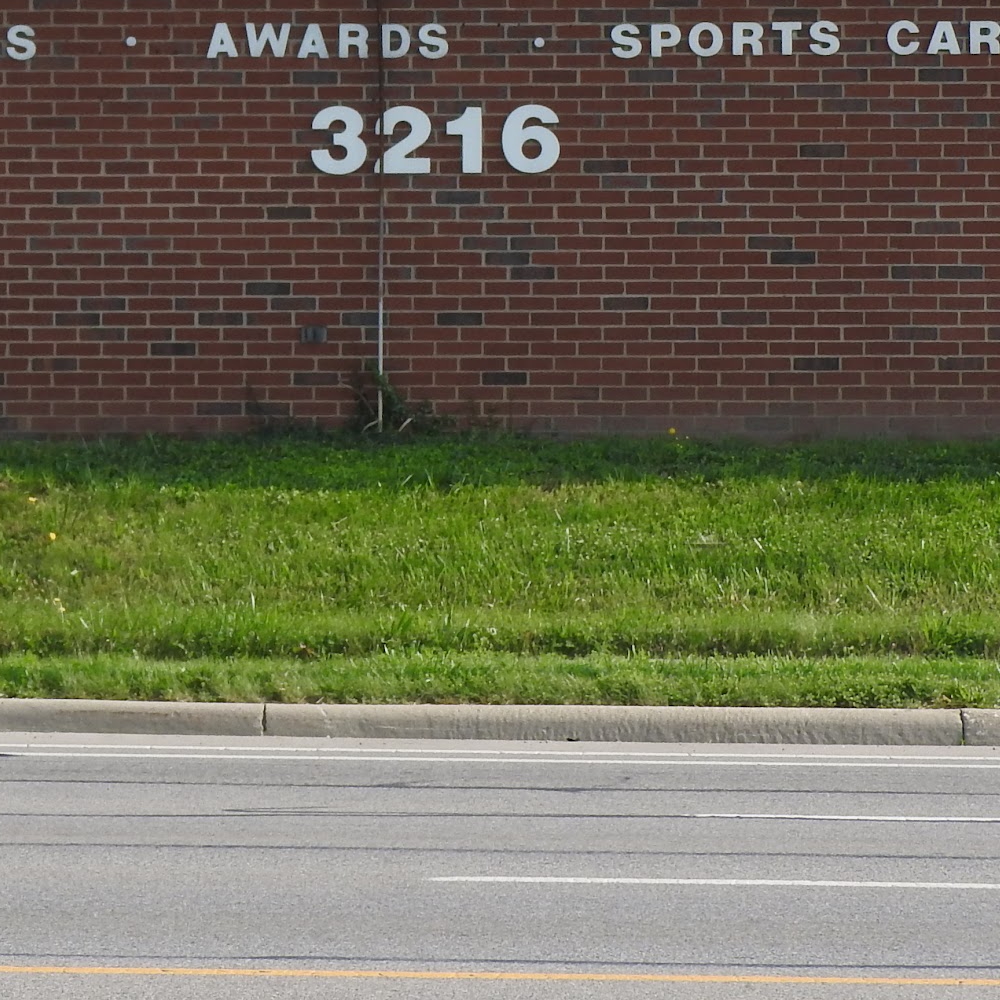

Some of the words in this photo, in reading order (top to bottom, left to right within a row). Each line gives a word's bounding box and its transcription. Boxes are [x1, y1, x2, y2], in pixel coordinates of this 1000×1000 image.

[206, 22, 449, 60] AWARDS
[610, 20, 841, 59] SPORTS
[886, 19, 1000, 56] CAR
[310, 103, 561, 175] 3216
